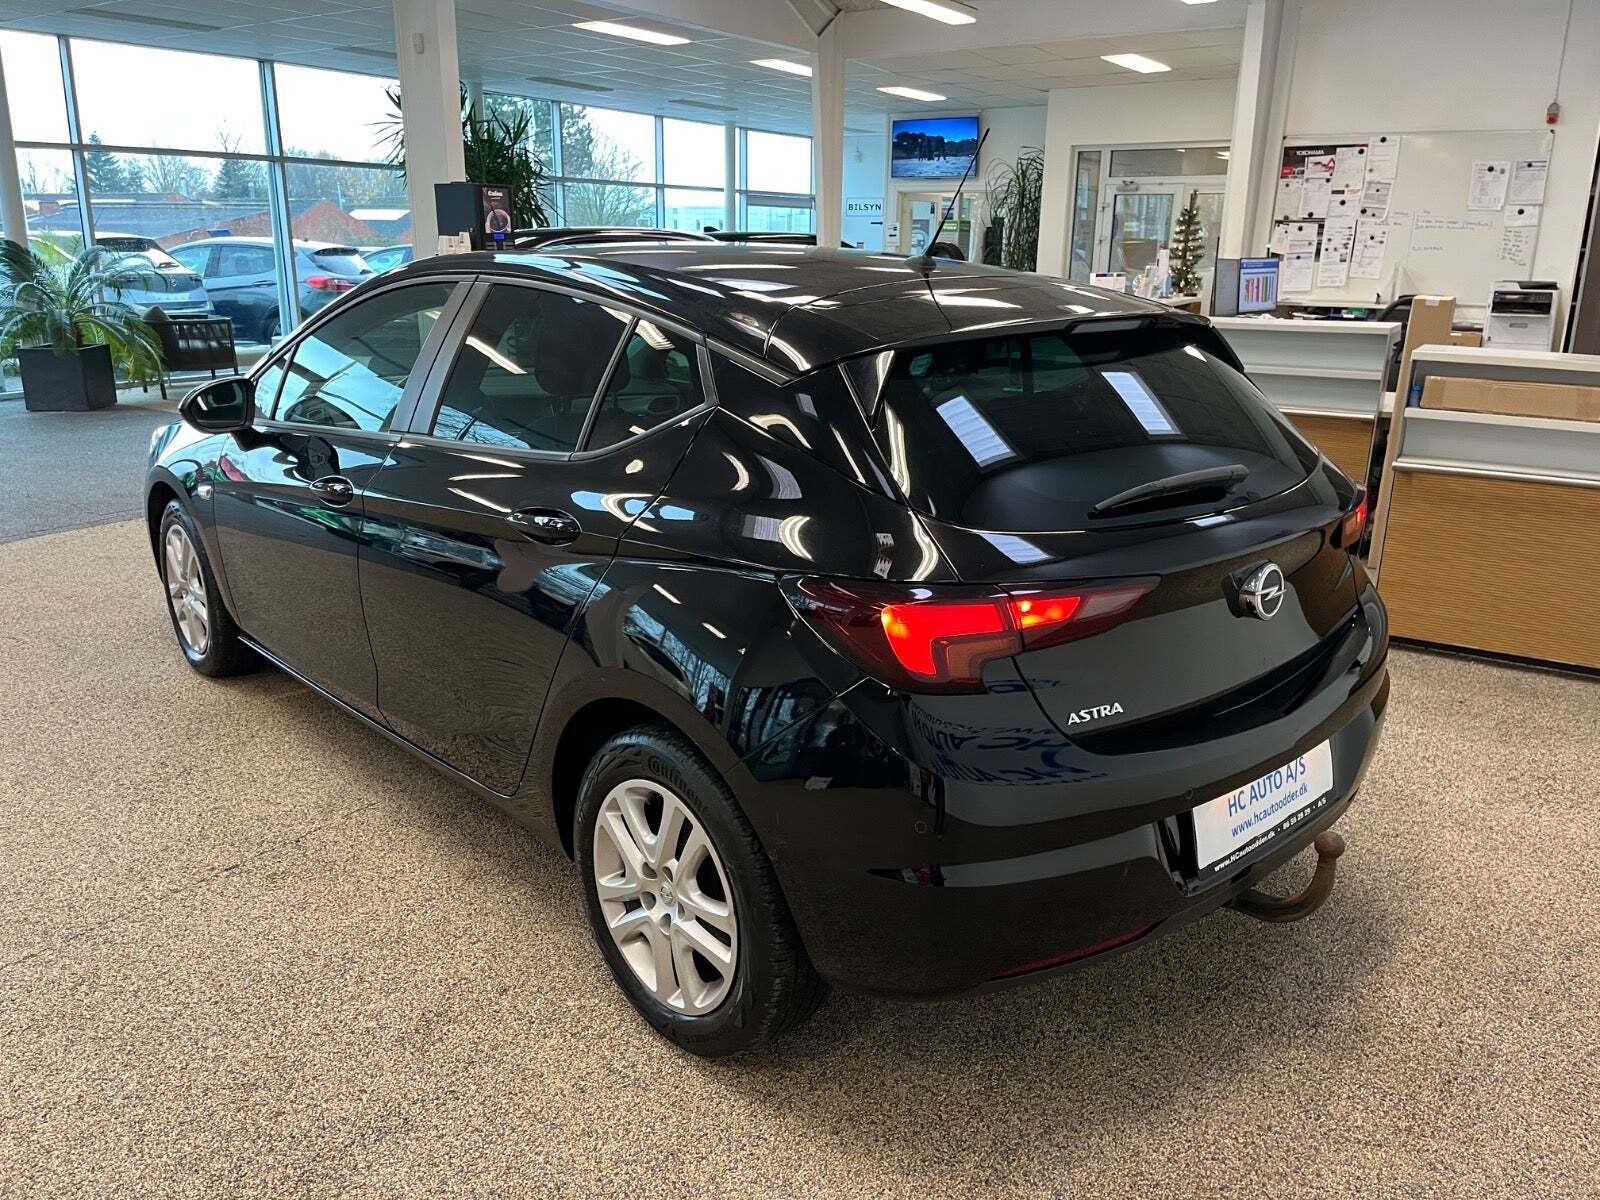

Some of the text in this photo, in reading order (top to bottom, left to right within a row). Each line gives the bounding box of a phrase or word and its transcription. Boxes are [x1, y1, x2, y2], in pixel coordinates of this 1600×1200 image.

[848, 203, 882, 211] BILSYN
[1067, 702, 1124, 726] ASTRA
[1227, 756, 1306, 817] HC AUTO A/S
[1231, 784, 1308, 837] www.hcautoodder.dk
